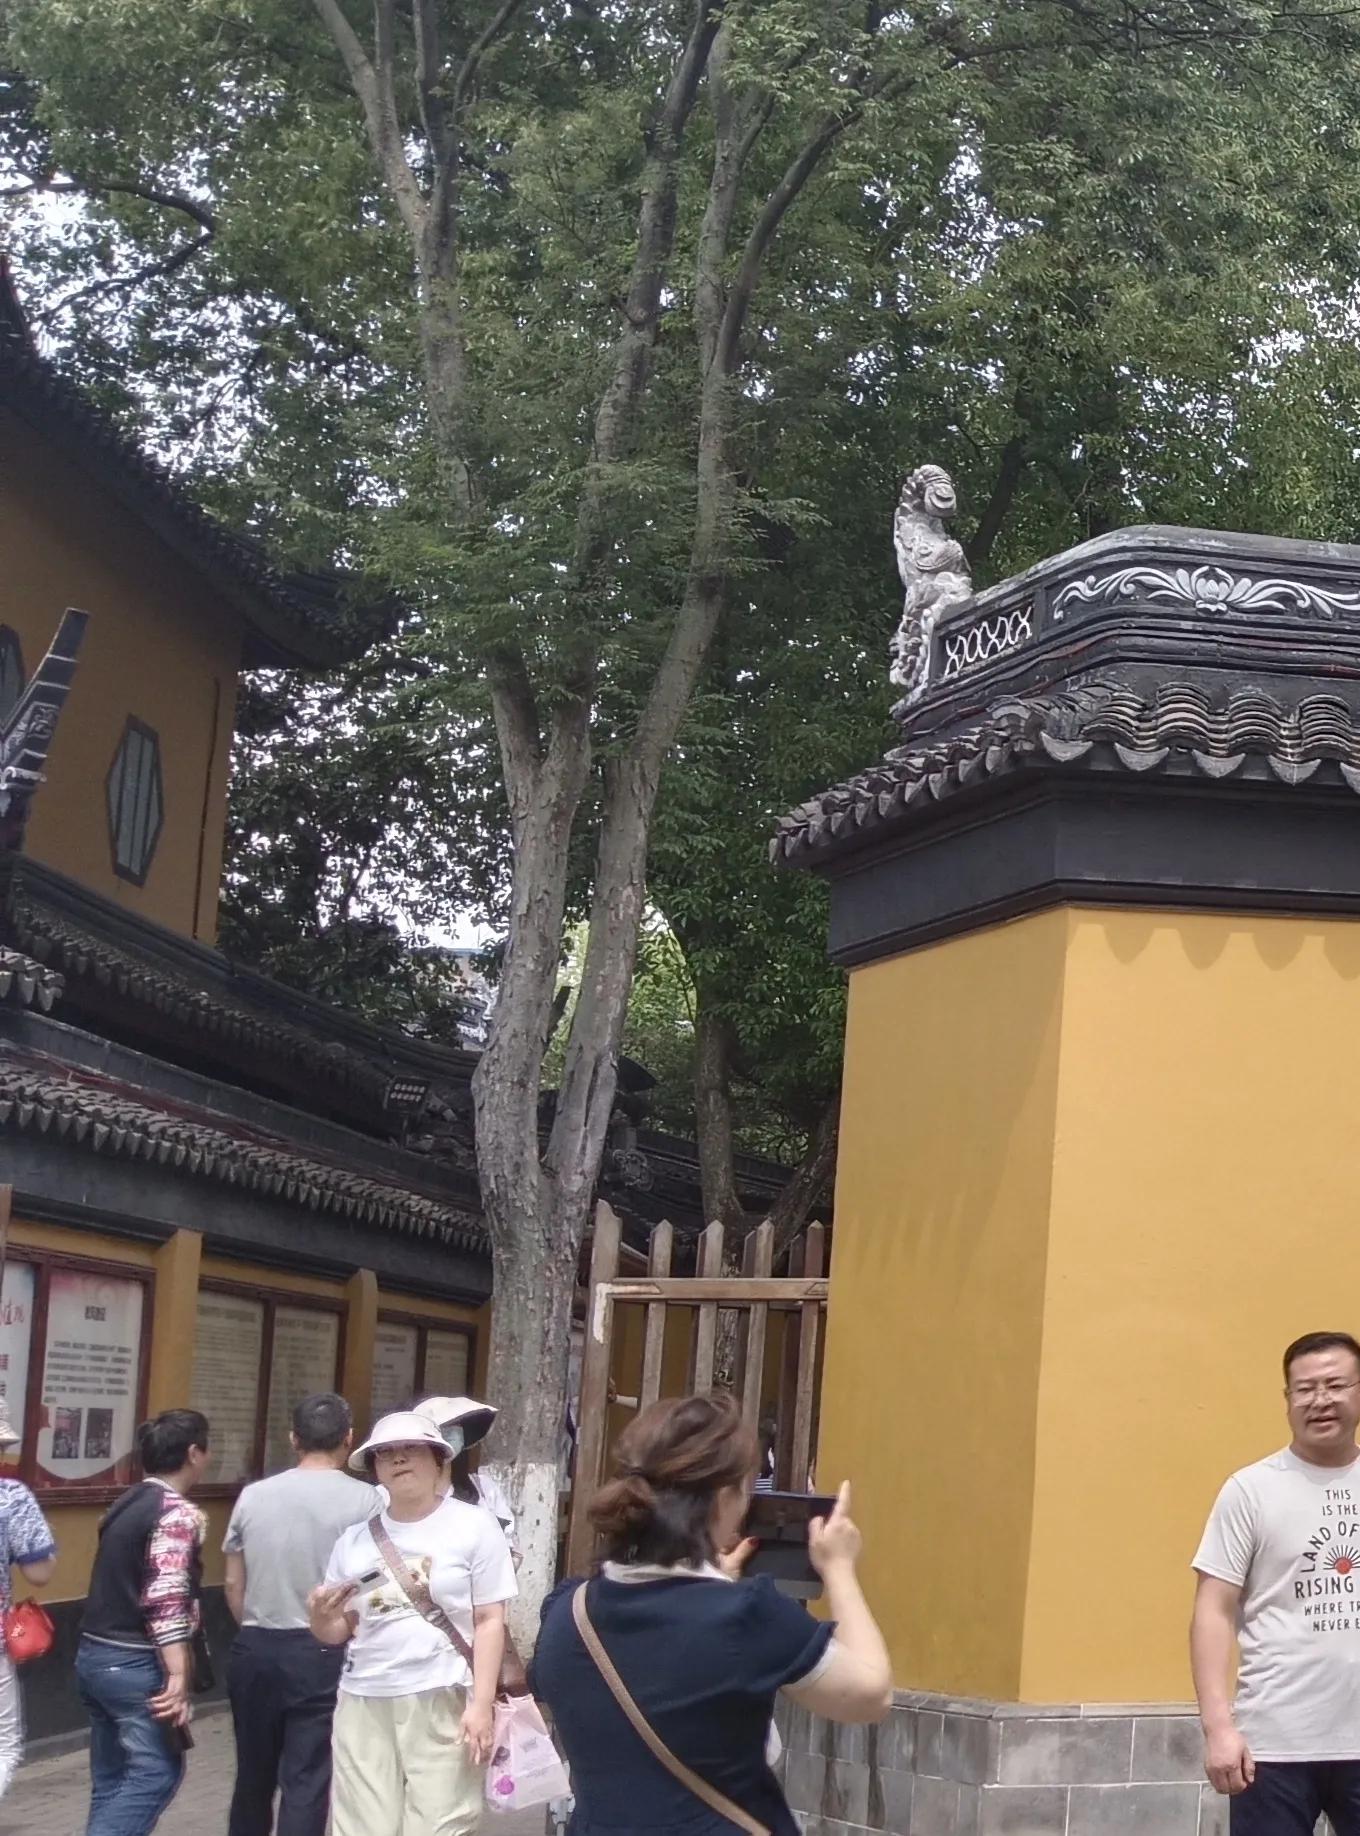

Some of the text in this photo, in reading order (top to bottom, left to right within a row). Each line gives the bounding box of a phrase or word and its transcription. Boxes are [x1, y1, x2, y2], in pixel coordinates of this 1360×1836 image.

[1325, 1489, 1351, 1500] THIS
[1322, 1504, 1359, 1516] IS THE
[1300, 1526, 1332, 1573] LAND
[1338, 1521, 1360, 1538] OF
[1294, 1575, 1354, 1599] RISING
[1305, 1601, 1343, 1616] WHERE
[1313, 1618, 1350, 1632] NEVER
